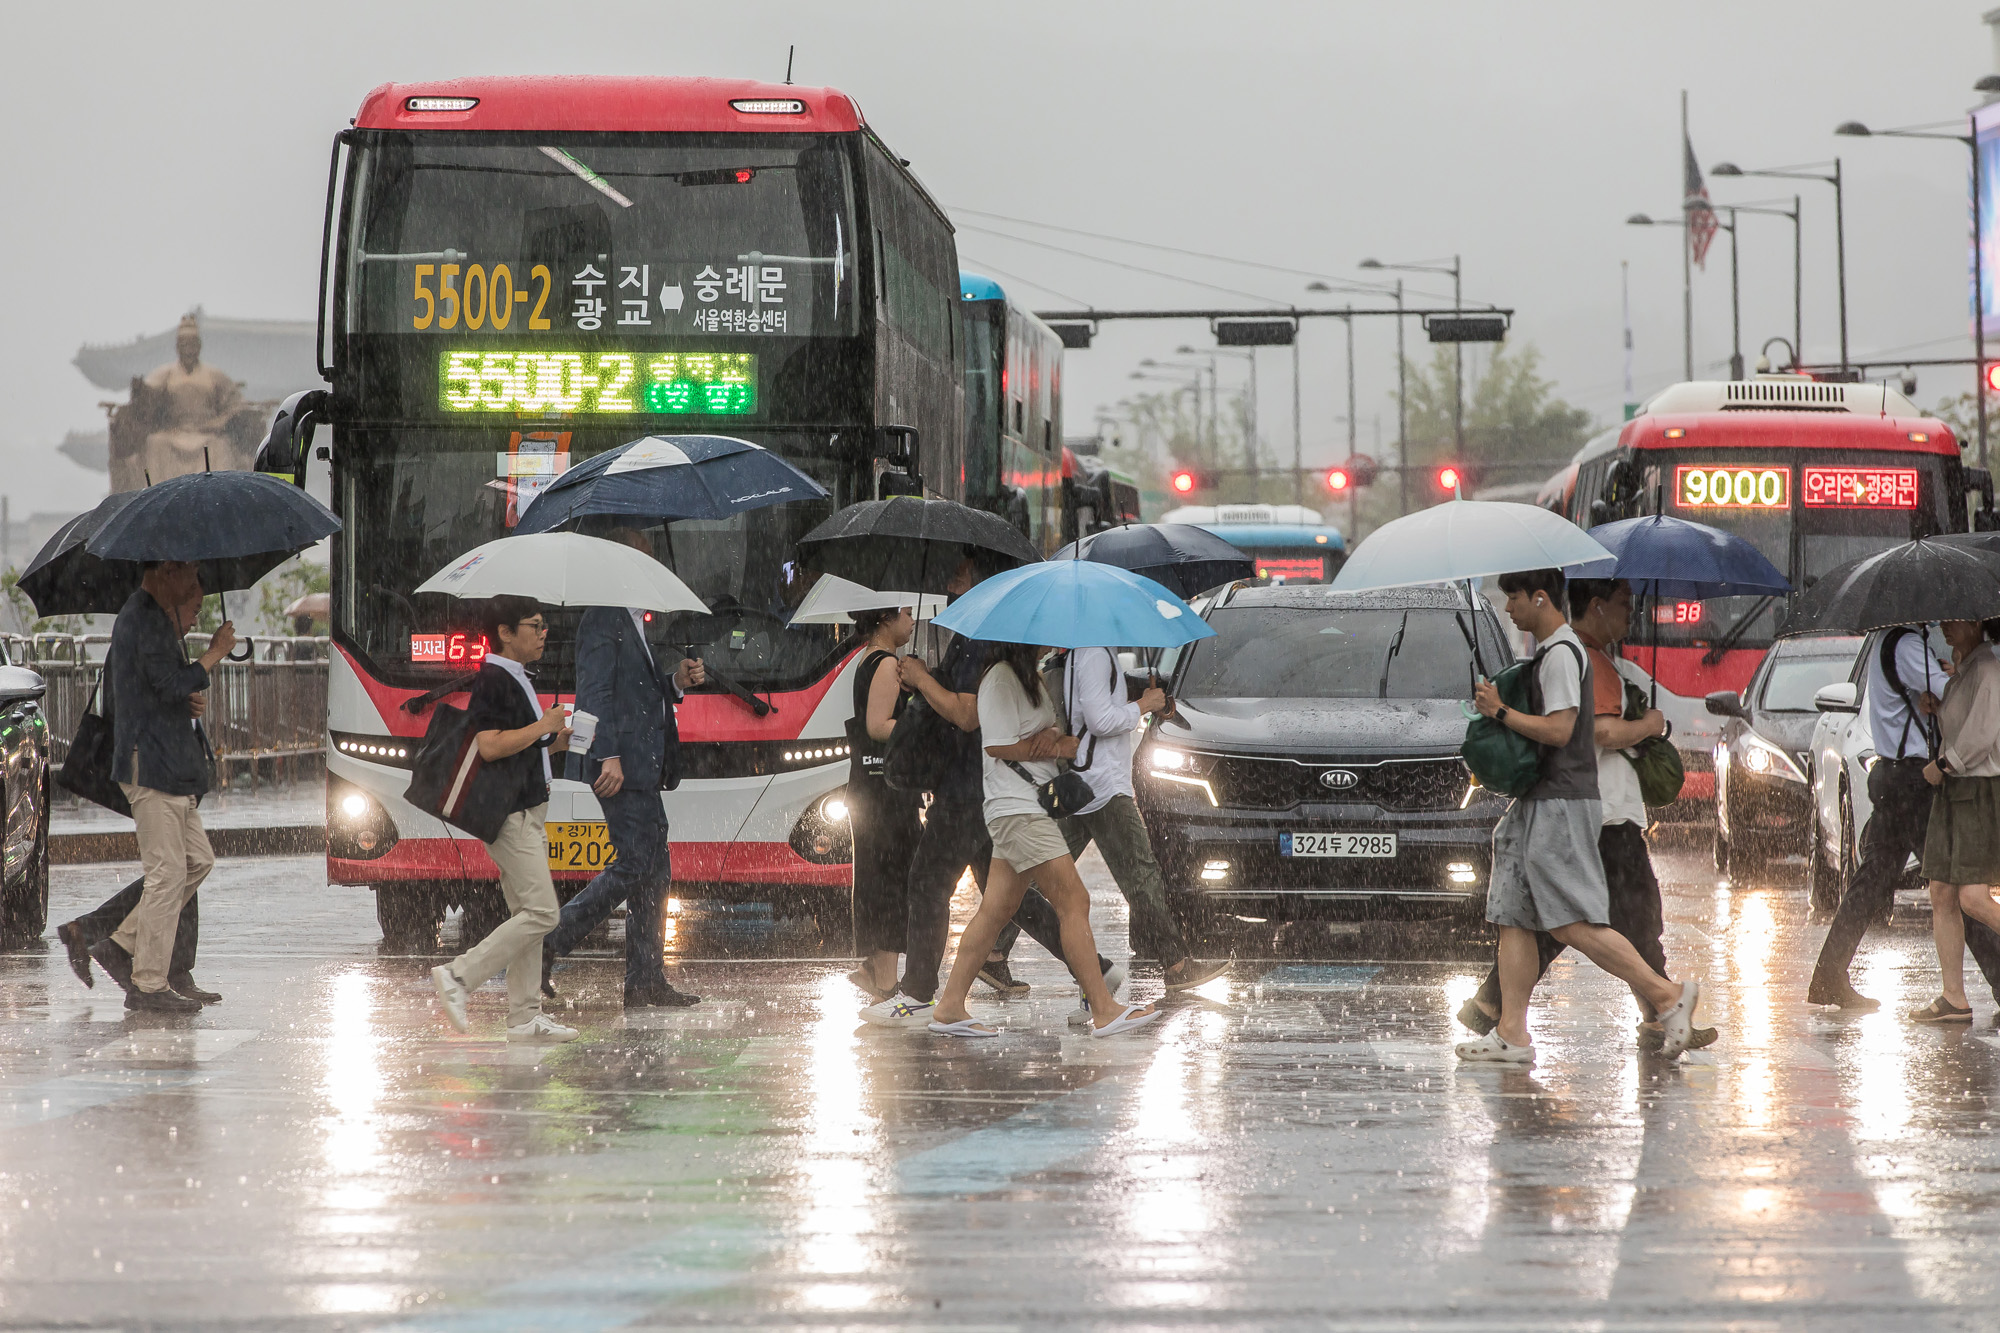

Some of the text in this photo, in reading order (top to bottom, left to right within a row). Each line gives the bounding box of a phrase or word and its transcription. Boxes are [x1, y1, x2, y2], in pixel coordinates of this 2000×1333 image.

[572, 264, 649, 297] 수지
[693, 265, 787, 303] 숭례문
[413, 263, 551, 331] 5500-2
[572, 298, 652, 331] 광교
[693, 308, 787, 333] 서울역환승센터
[447, 353, 633, 410] 5500-2
[1685, 469, 1781, 506] 9000
[1807, 473, 1915, 506] 오리역 광화문
[1676, 602, 1701, 623] 38
[412, 640, 446, 656] 빈자리
[1326, 773, 1353, 786] KIA
[567, 825, 607, 838] 경기 7
[1294, 836, 1393, 855] 324두 2985
[548, 840, 617, 867] 바 202
